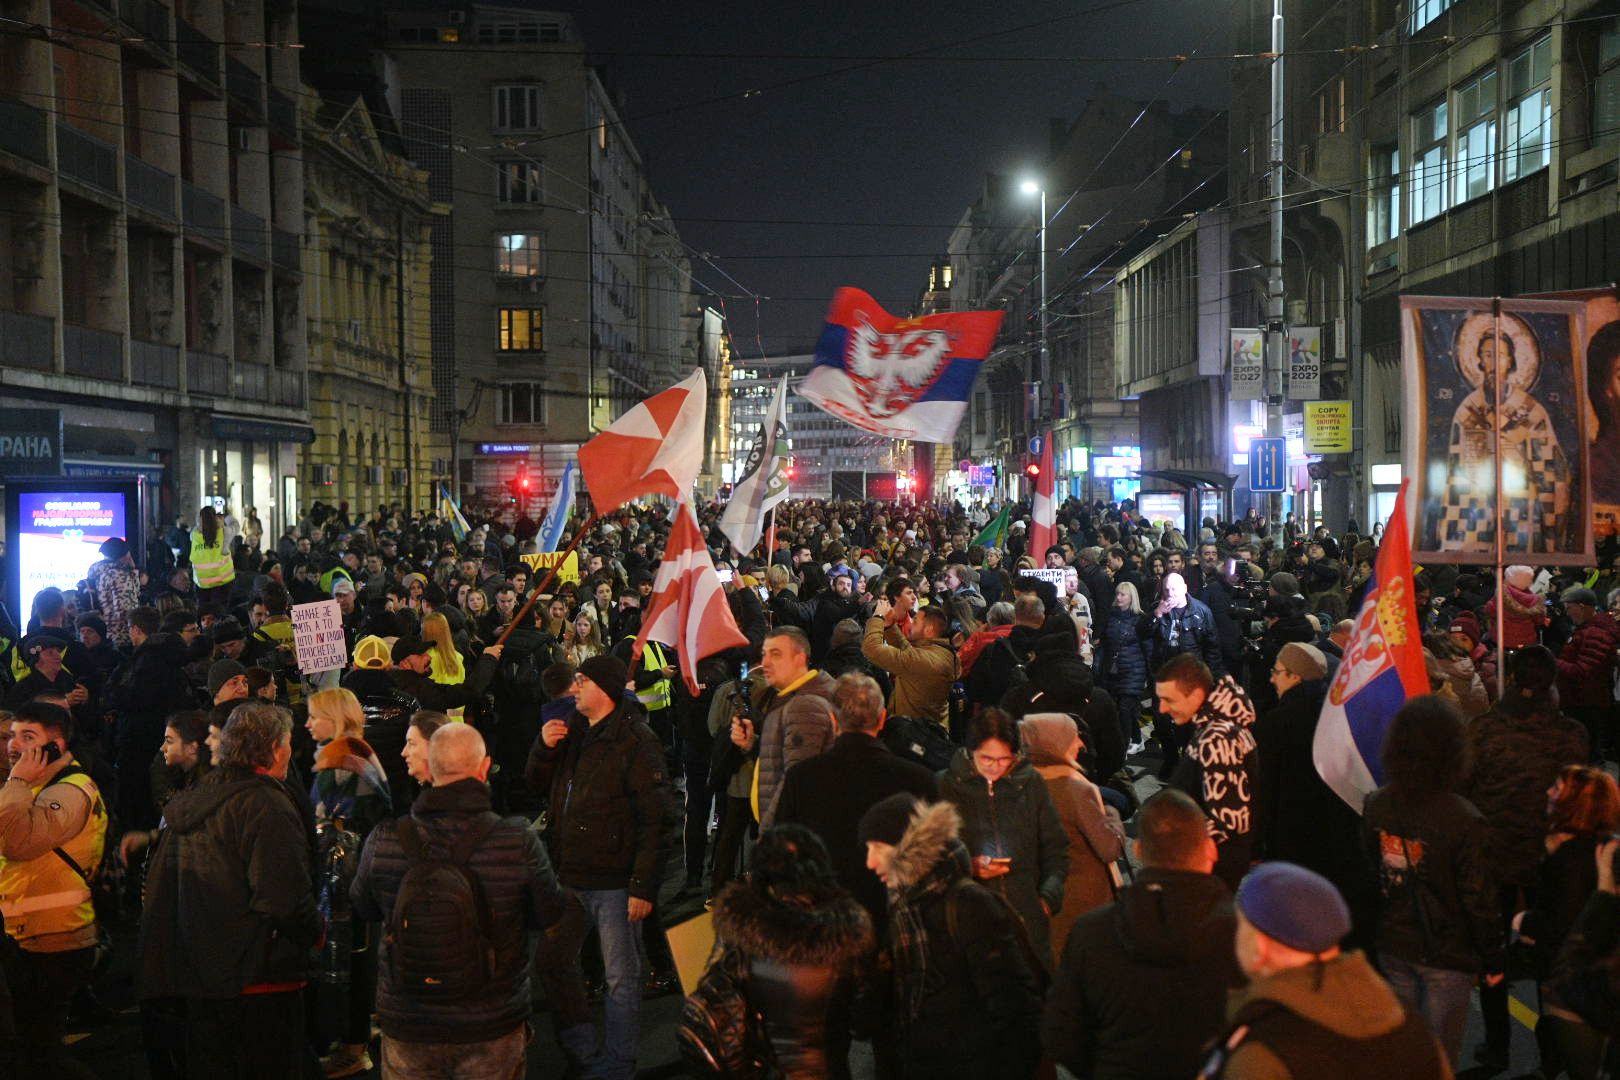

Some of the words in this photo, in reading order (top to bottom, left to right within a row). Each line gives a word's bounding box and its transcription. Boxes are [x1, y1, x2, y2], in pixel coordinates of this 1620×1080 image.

[1233, 373, 1261, 381] 2027
[1291, 372, 1319, 380] 2027
[194, 541, 220, 551] PRES
